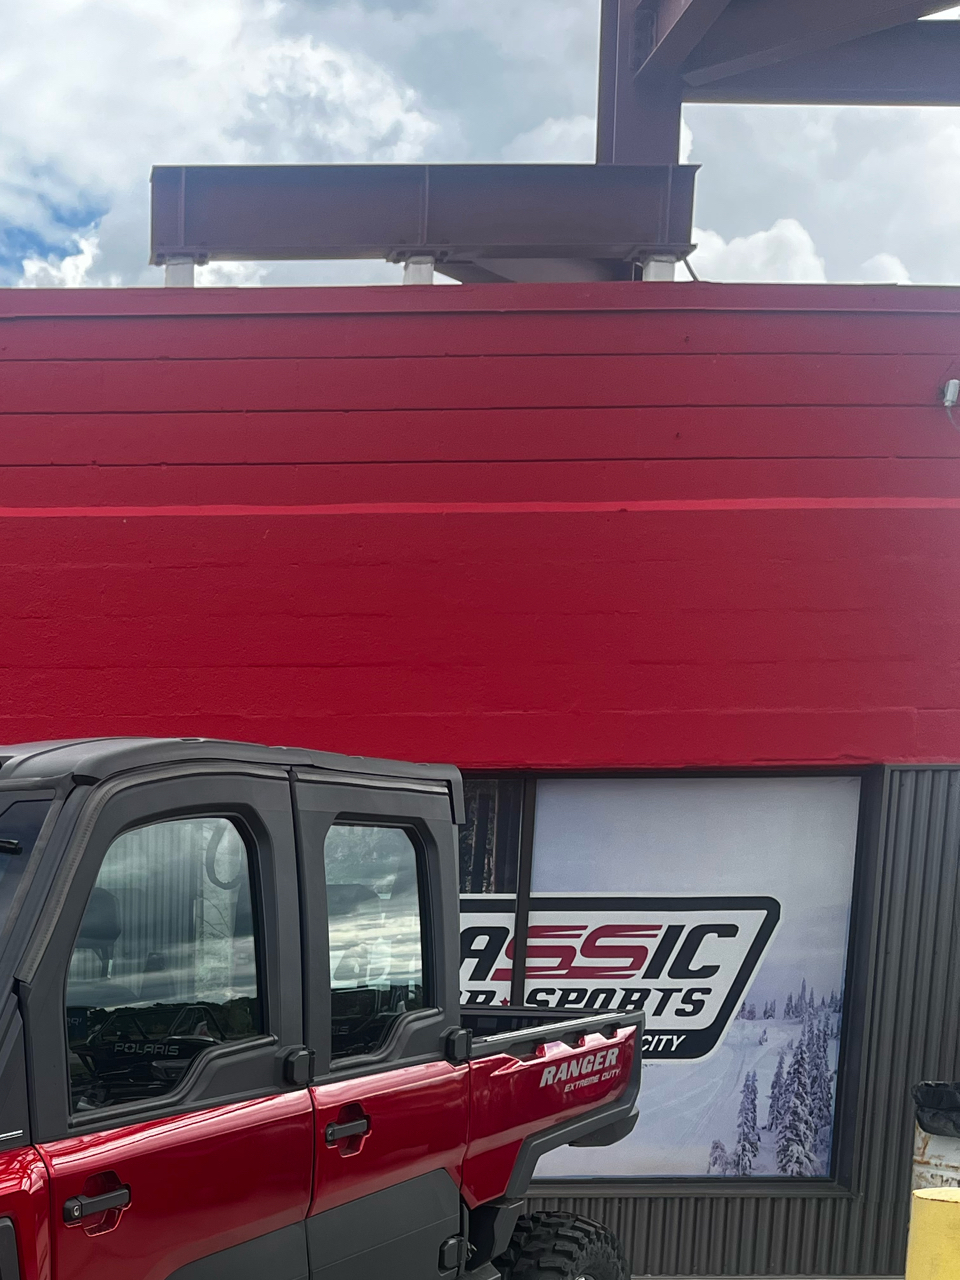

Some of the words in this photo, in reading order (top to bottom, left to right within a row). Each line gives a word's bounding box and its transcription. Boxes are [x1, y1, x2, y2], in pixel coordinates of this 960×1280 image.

[460, 924, 740, 981] ASSIC
[114, 1042, 180, 1056] POLARIS
[642, 1035, 686, 1052] CITY
[539, 1047, 619, 1088] RANGER
[564, 1074, 600, 1093] EXTREME
[601, 1069, 621, 1082] DUTY
